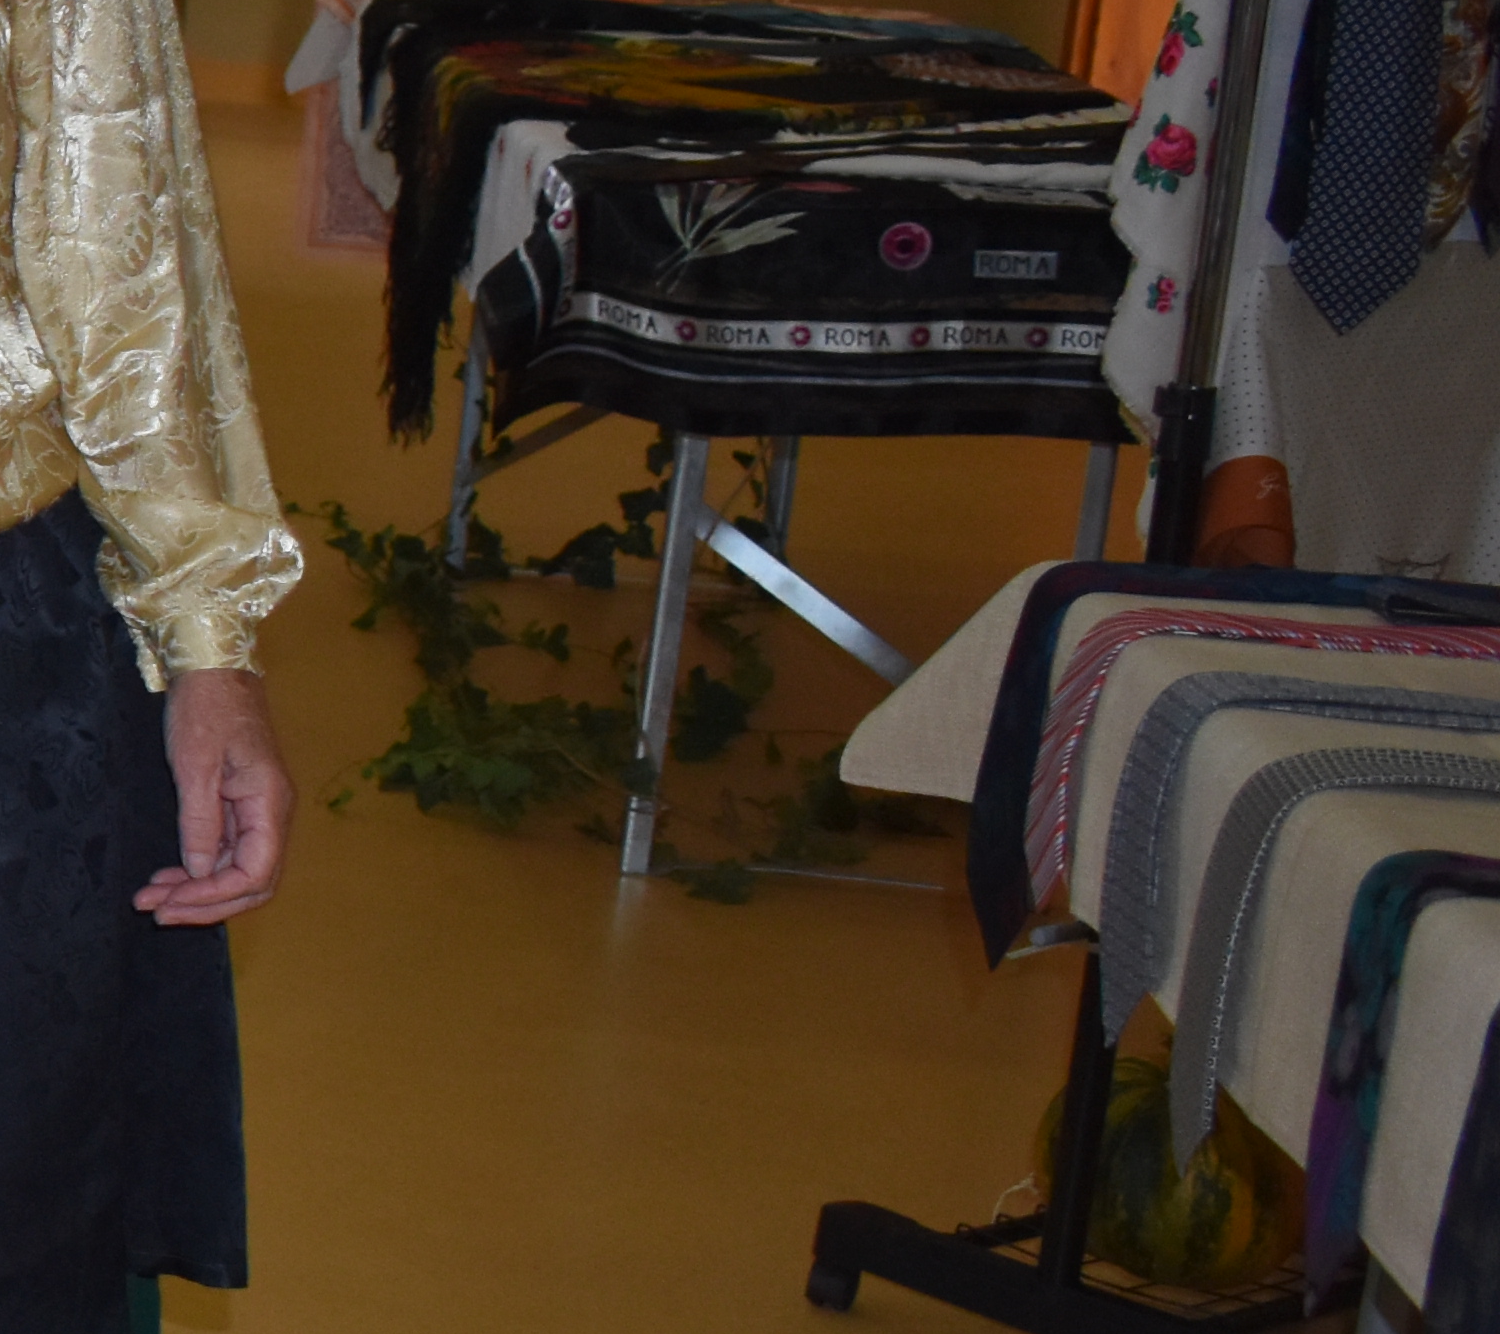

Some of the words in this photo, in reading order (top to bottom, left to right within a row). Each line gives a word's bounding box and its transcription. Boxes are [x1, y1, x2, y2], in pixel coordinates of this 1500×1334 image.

[978, 254, 1050, 275] ROMA
[597, 299, 657, 335] ROMA
[705, 324, 771, 345] ROMA
[823, 327, 892, 347] ROMA
[942, 325, 1009, 346] ROMA
[1060, 330, 1106, 349] ROM
